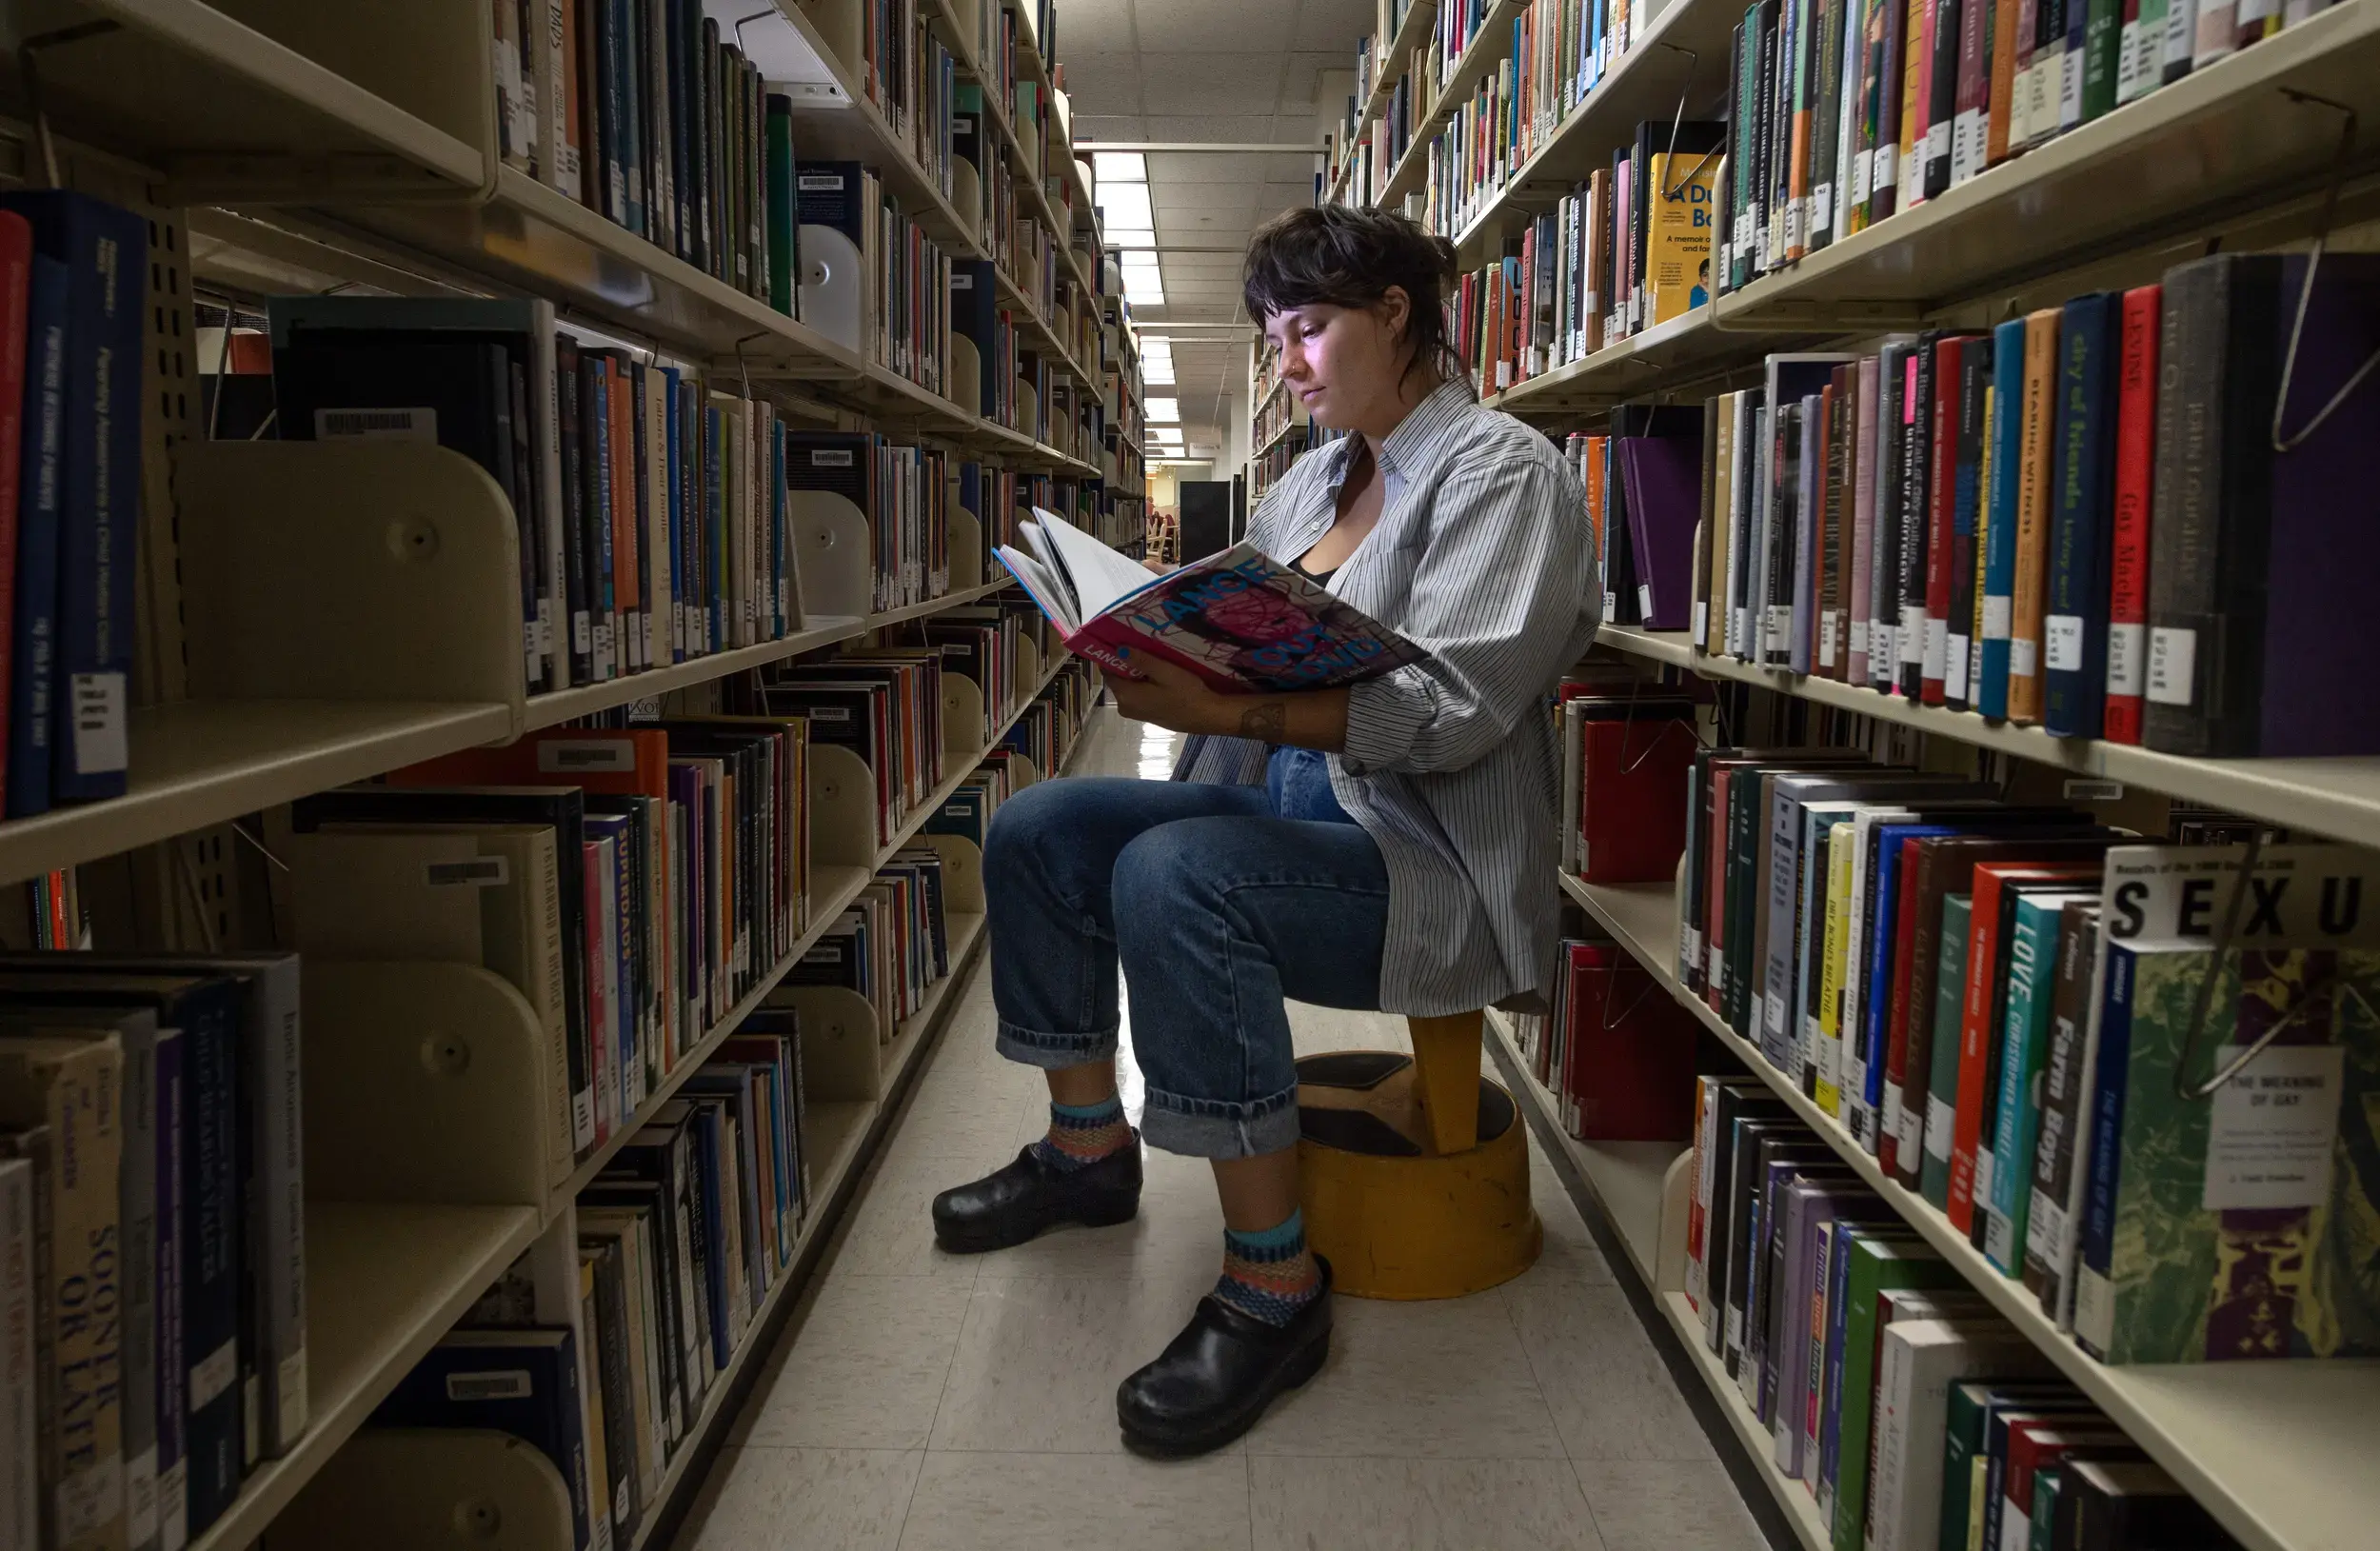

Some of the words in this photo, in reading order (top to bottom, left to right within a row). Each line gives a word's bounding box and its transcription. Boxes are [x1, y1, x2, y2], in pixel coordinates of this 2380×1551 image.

[550, 6, 563, 50] DADS
[1823, 5, 1837, 95] Homosexuality
[1965, 7, 1977, 61] CULTURE
[1918, 343, 1931, 369] The
[2067, 332, 2090, 381] city
[2127, 308, 2146, 392] LEVINE
[1916, 374, 1929, 405] Rise
[2070, 386, 2087, 413] of
[1915, 407, 1927, 434] and
[2024, 378, 2040, 455] BEARING
[1826, 442, 1842, 473] GAY
[1914, 438, 1926, 466] Fall
[2064, 419, 2087, 510] friends
[599, 417, 612, 557] FATHERHOOD
[1825, 476, 1842, 542] CULTURE
[2021, 460, 2037, 535] WITNESS
[2119, 492, 2140, 533] Gay
[1909, 515, 1922, 565] Culture
[1134, 558, 1278, 632] LANCE
[2113, 545, 2135, 619] Macho
[1082, 644, 1128, 672] LANCE
[1253, 623, 1335, 667] OUT
[1275, 636, 1382, 691] LOUD
[618, 826, 631, 961] SUPERDADS
[1827, 899, 1837, 922] DRY
[1825, 924, 1836, 961] BONES
[1822, 964, 1834, 1014] BREATHE
[2000, 1010, 2024, 1105] CHRISTOPHER
[2048, 1015, 2075, 1099] Farm
[1996, 1110, 2017, 1159] STREET
[2037, 1106, 2065, 1183] Boys
[2095, 1119, 2113, 1181] MEANING
[1812, 1242, 1828, 1292] British
[57, 1274, 91, 1342] OR
[89, 1223, 120, 1411] SOONER
[1809, 1294, 1825, 1340] queer
[1807, 1340, 1822, 1393] history
